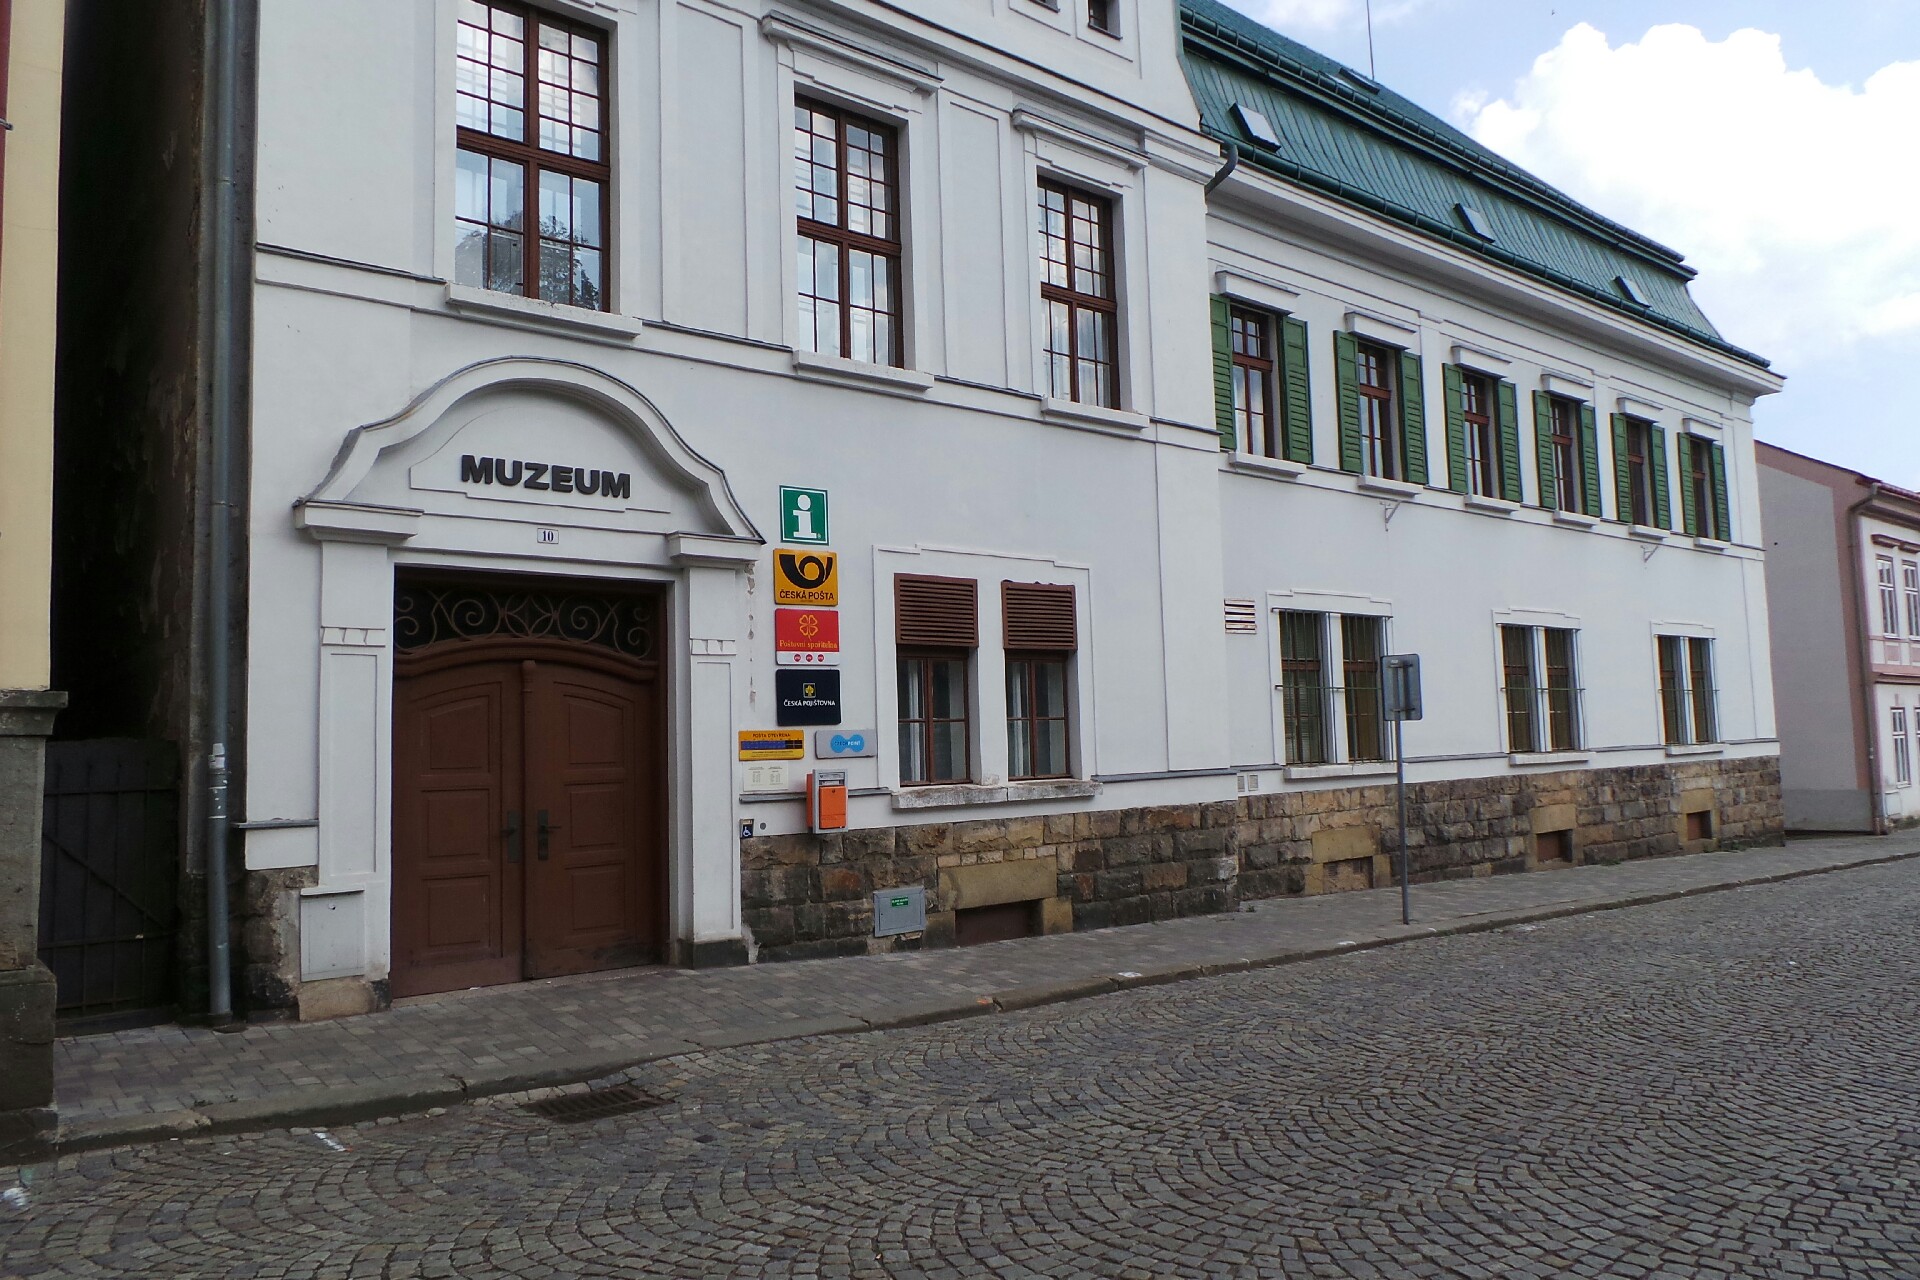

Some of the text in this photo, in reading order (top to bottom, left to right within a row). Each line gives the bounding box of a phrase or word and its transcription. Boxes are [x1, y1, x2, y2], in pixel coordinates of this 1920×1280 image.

[461, 454, 631, 499] MUZEUM
[542, 530, 554, 542] 10
[779, 589, 835, 601] ČESKÁ POŠTA
[779, 639, 838, 649] Poštovní spořitelna
